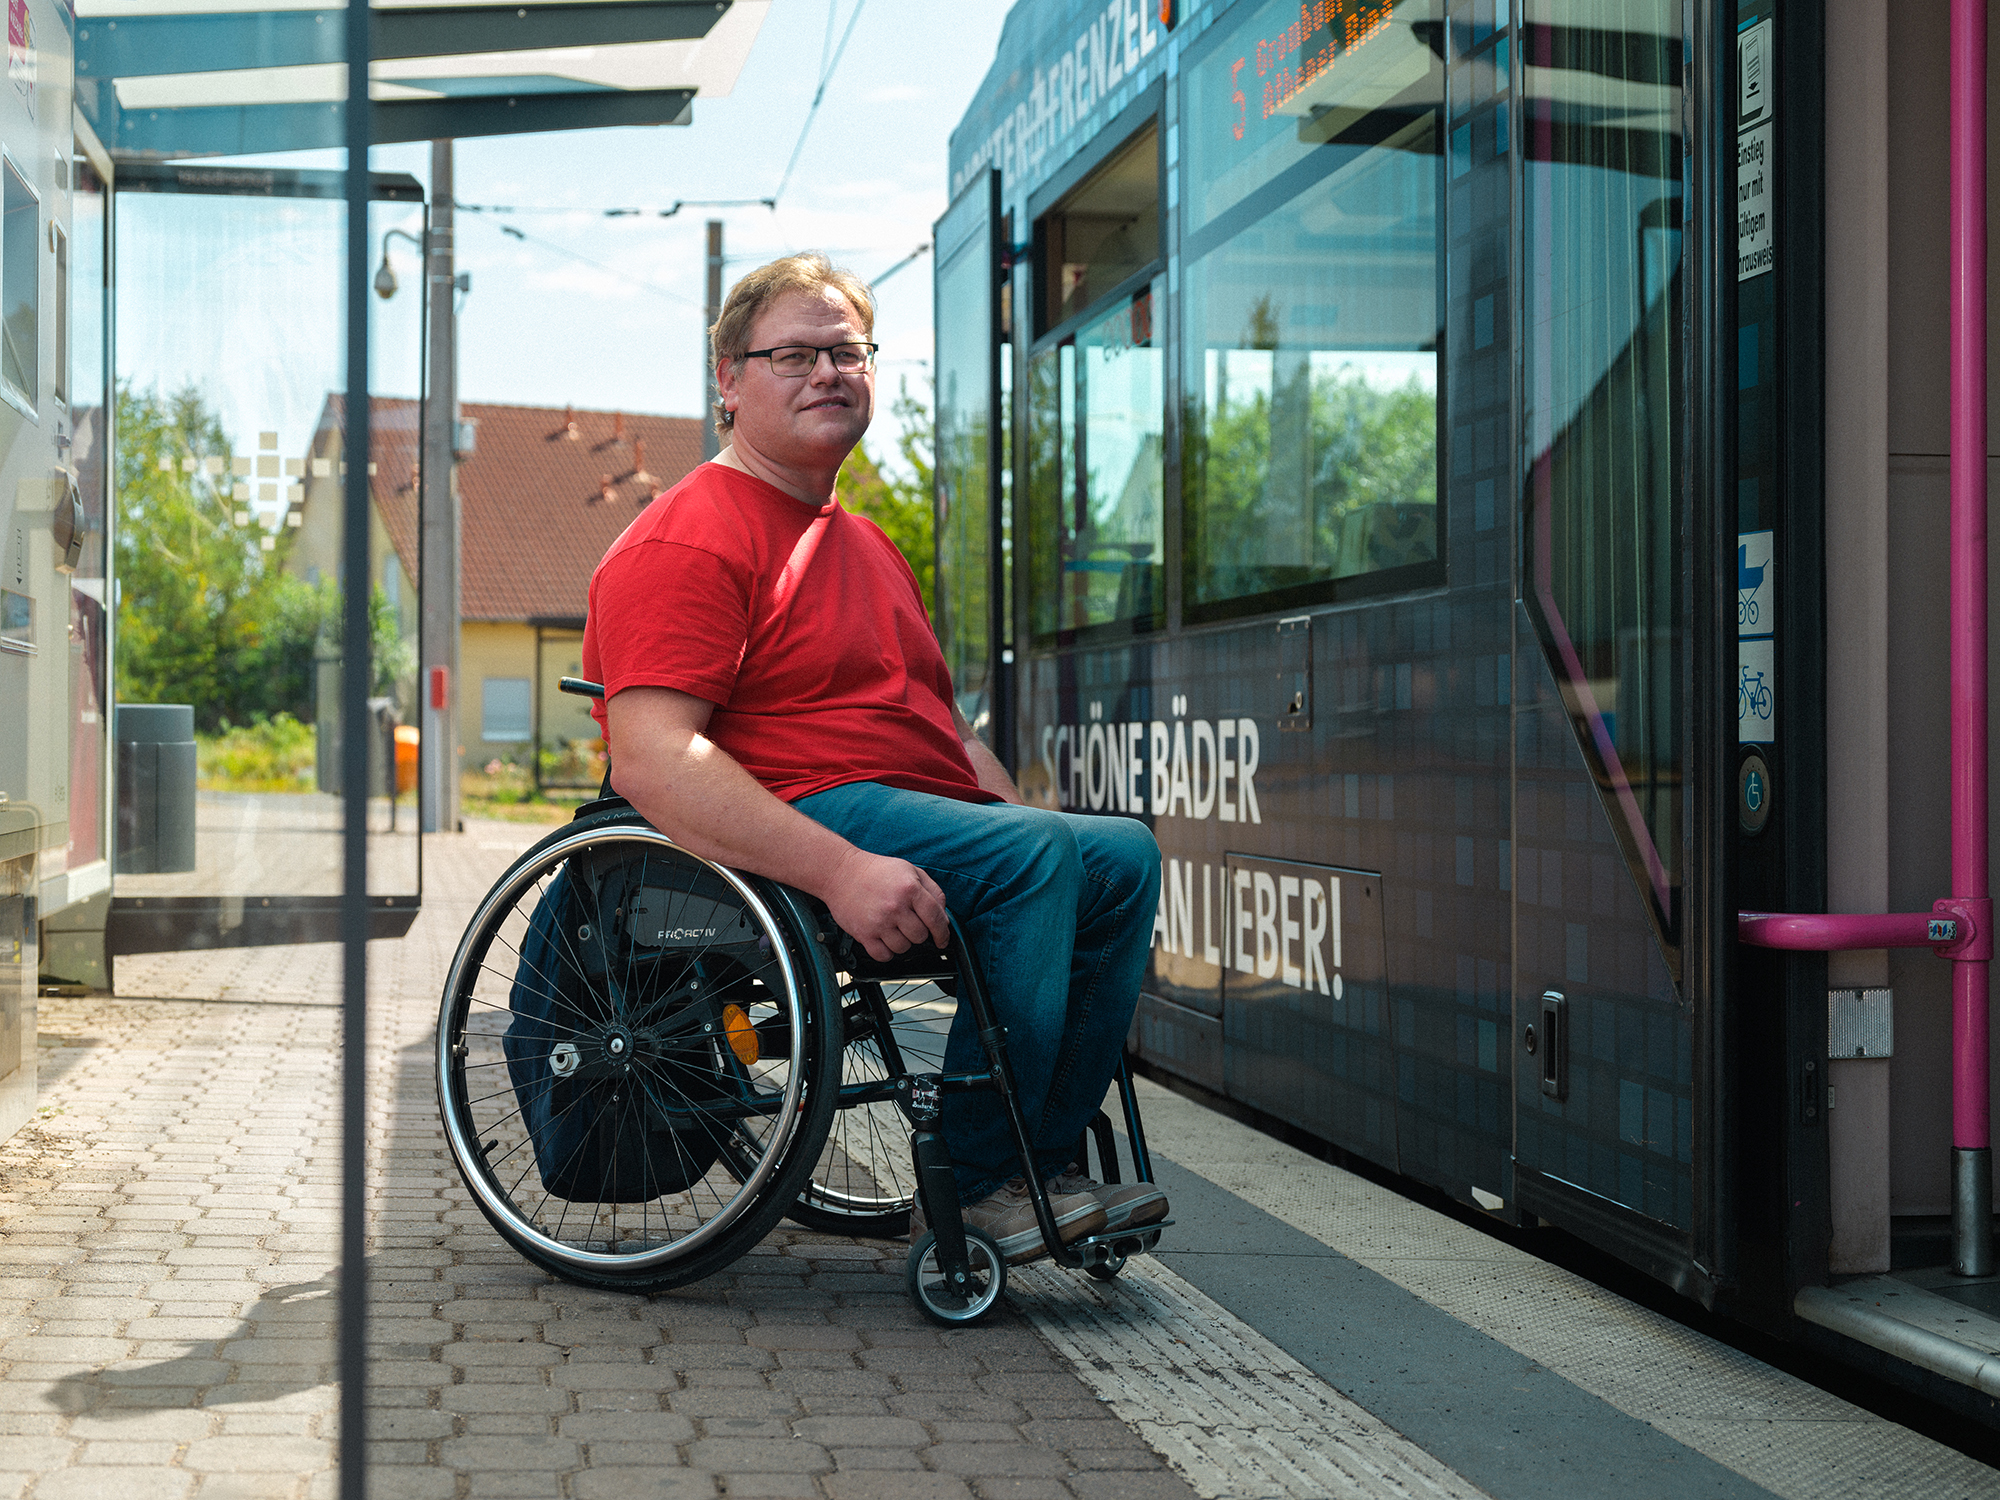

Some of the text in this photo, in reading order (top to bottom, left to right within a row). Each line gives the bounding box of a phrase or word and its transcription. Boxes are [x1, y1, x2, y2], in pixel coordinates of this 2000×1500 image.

[1231, 57, 1245, 141] 5
[1739, 169, 1763, 203] nur mit
[1739, 209, 1765, 242] ültigem
[1041, 694, 1262, 824] SCHÖNE BÄDER
[1150, 858, 1344, 1001] AN LIEBER!
